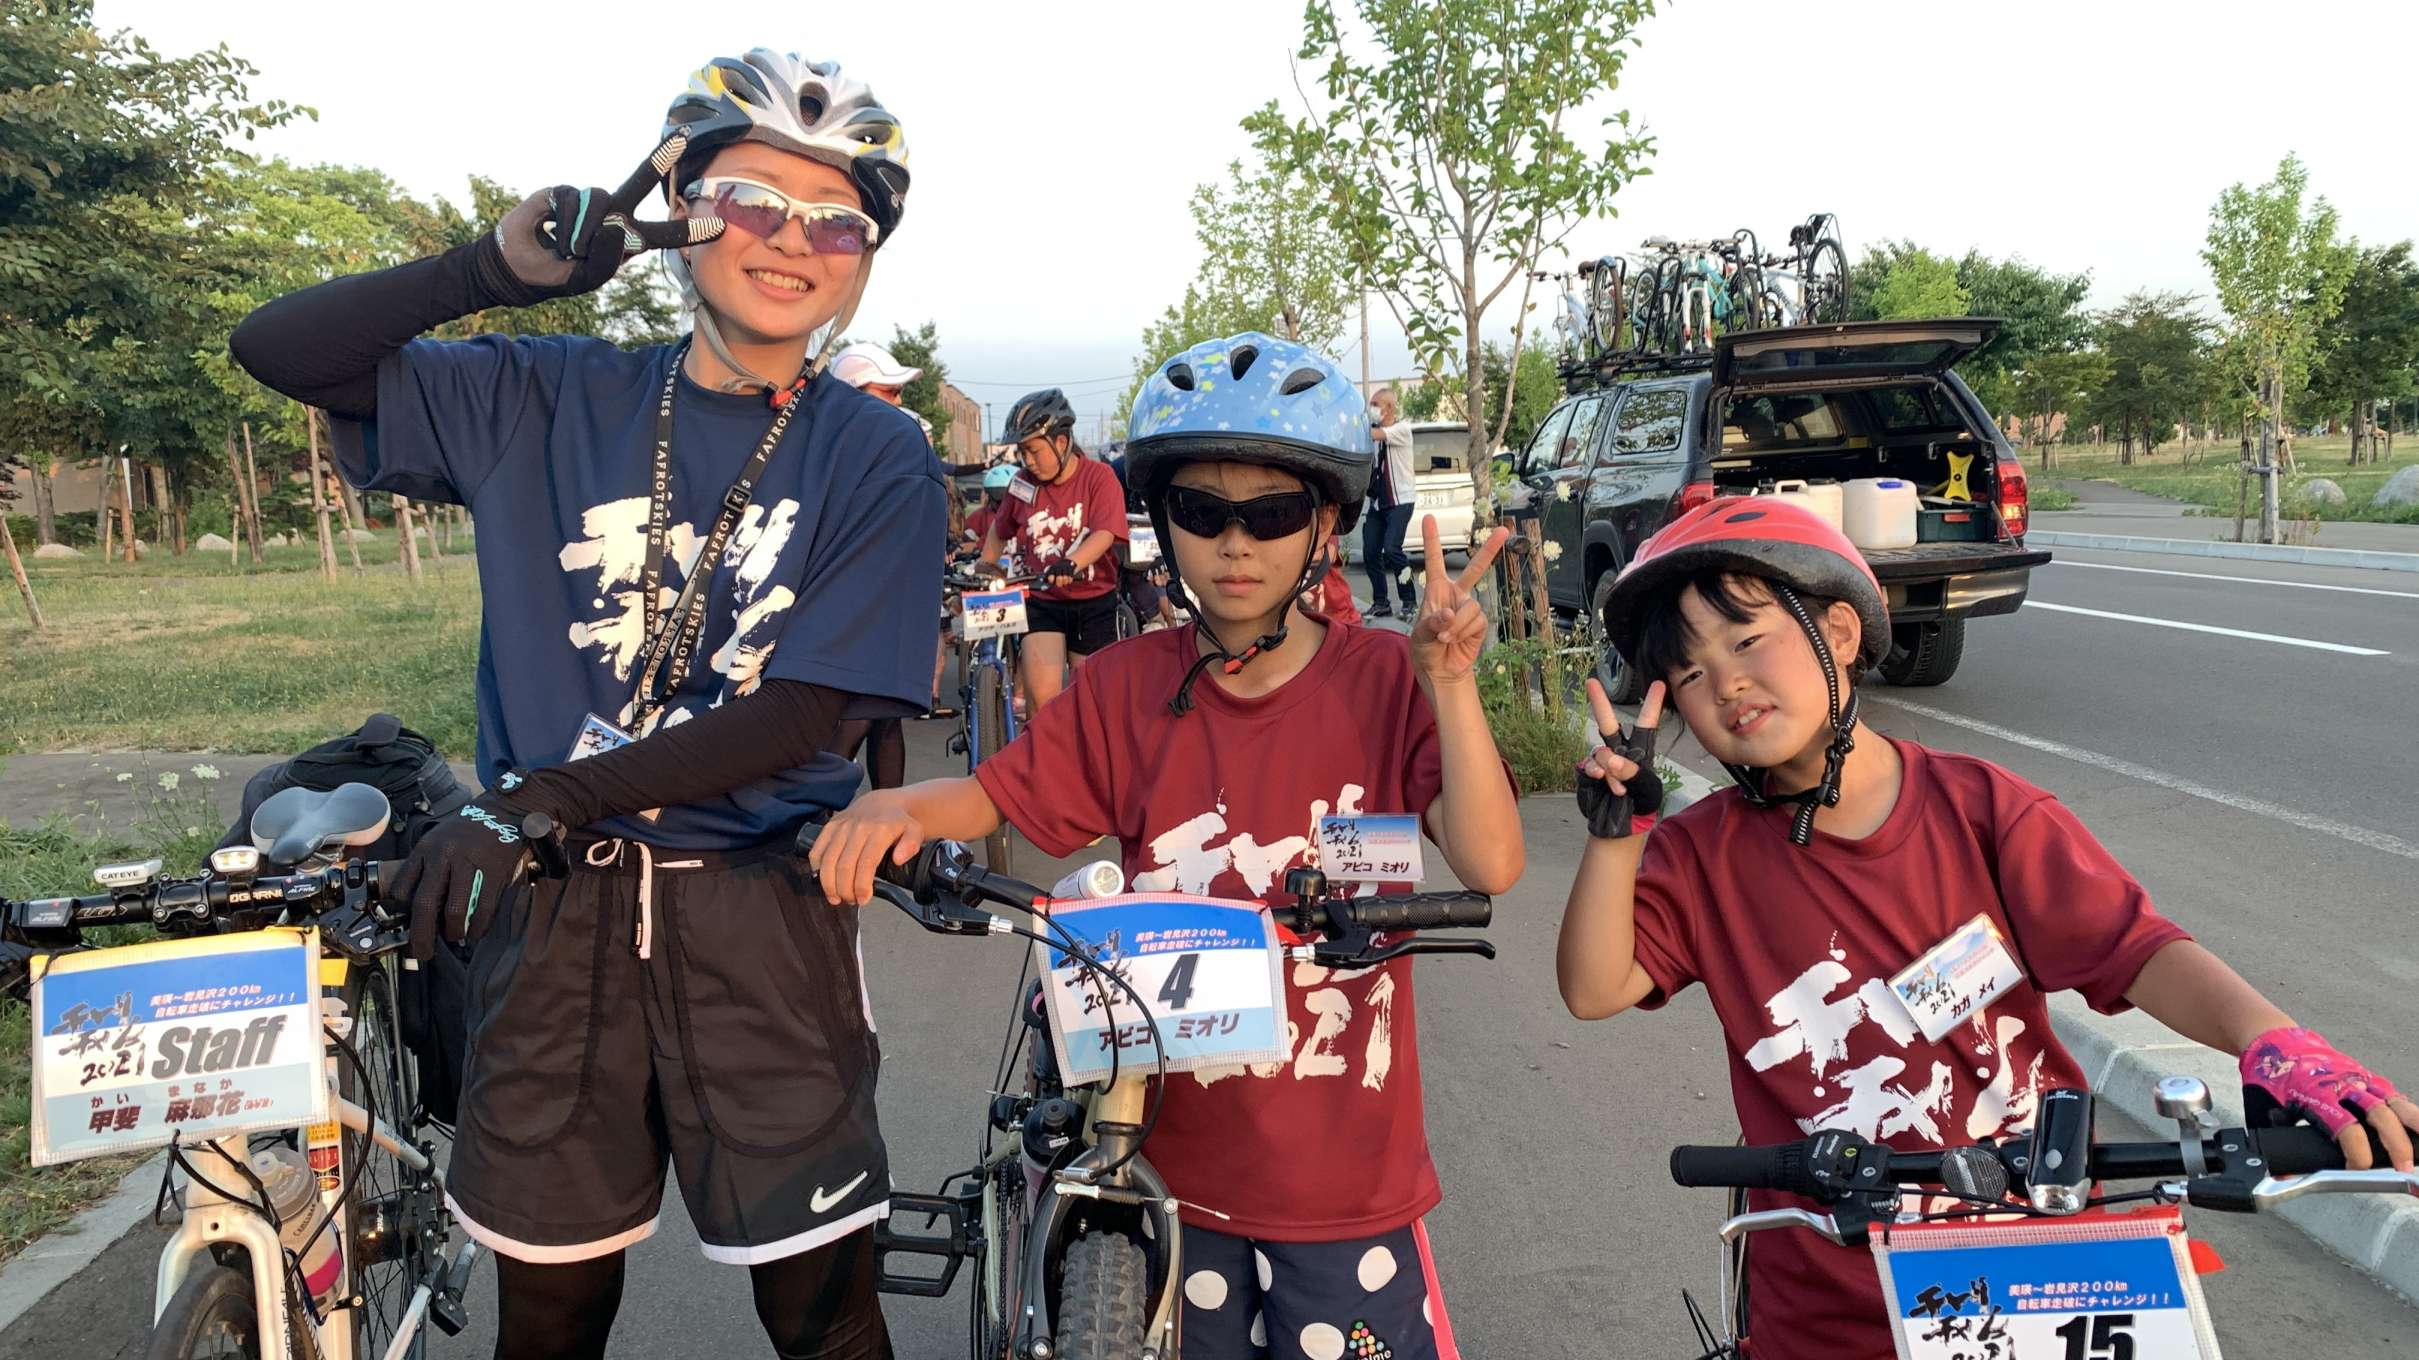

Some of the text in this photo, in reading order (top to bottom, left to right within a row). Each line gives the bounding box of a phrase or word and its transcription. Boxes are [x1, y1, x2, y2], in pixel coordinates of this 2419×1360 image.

[651, 440, 668, 546] FAFROTSKIES
[996, 608, 1006, 623] 3
[101, 869, 139, 881] CATEYE
[1341, 861, 1410, 873] アビコ ミオリ
[1157, 952, 1201, 1011] 4
[1951, 977, 1996, 1019] カガ メイ
[151, 1013, 288, 1080] Staff
[1098, 1012, 1241, 1051] アビコ ミオリ
[88, 1105, 142, 1135] 甲斐
[2055, 1313, 2135, 1360] 15
